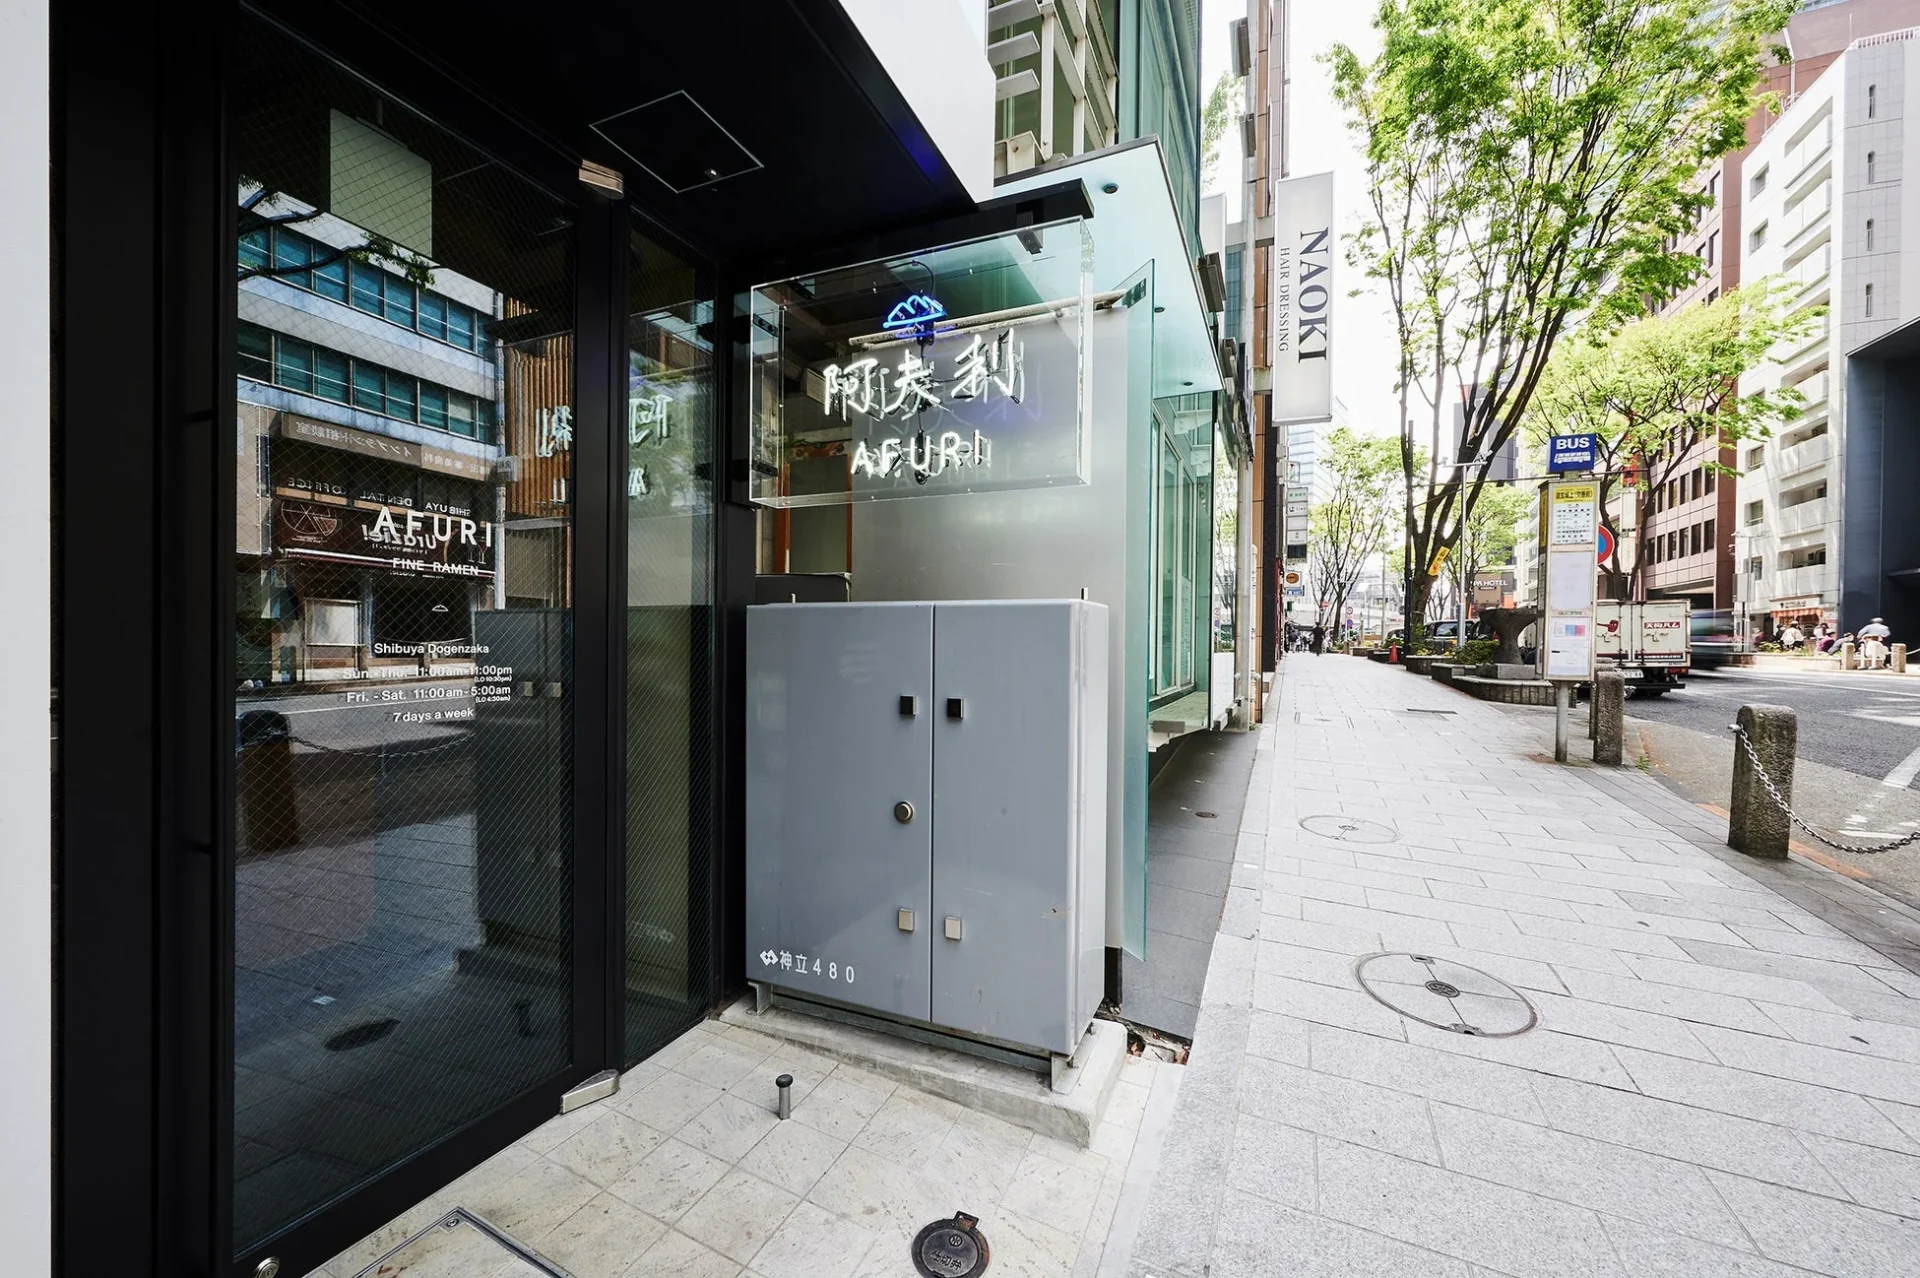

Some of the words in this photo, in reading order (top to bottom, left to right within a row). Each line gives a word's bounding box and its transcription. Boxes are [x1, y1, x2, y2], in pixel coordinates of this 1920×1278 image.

[1280, 247, 1290, 279] HAIR
[1298, 227, 1329, 363] NAOKI
[1279, 284, 1290, 352] DRESSING
[851, 429, 983, 478] AFURI
[1556, 437, 1590, 450] BUS
[374, 505, 492, 548] AFURI
[392, 557, 425, 571] FINE
[433, 561, 479, 576] RAMEN
[374, 643, 425, 656] Shibuya
[427, 643, 490, 656] Dogenzaka
[347, 692, 369, 703] Fri.
[381, 690, 407, 701] Sat.
[393, 713, 401, 722] 7
[403, 711, 431, 724] days
[434, 712, 442, 720] a
[445, 708, 474, 719] week
